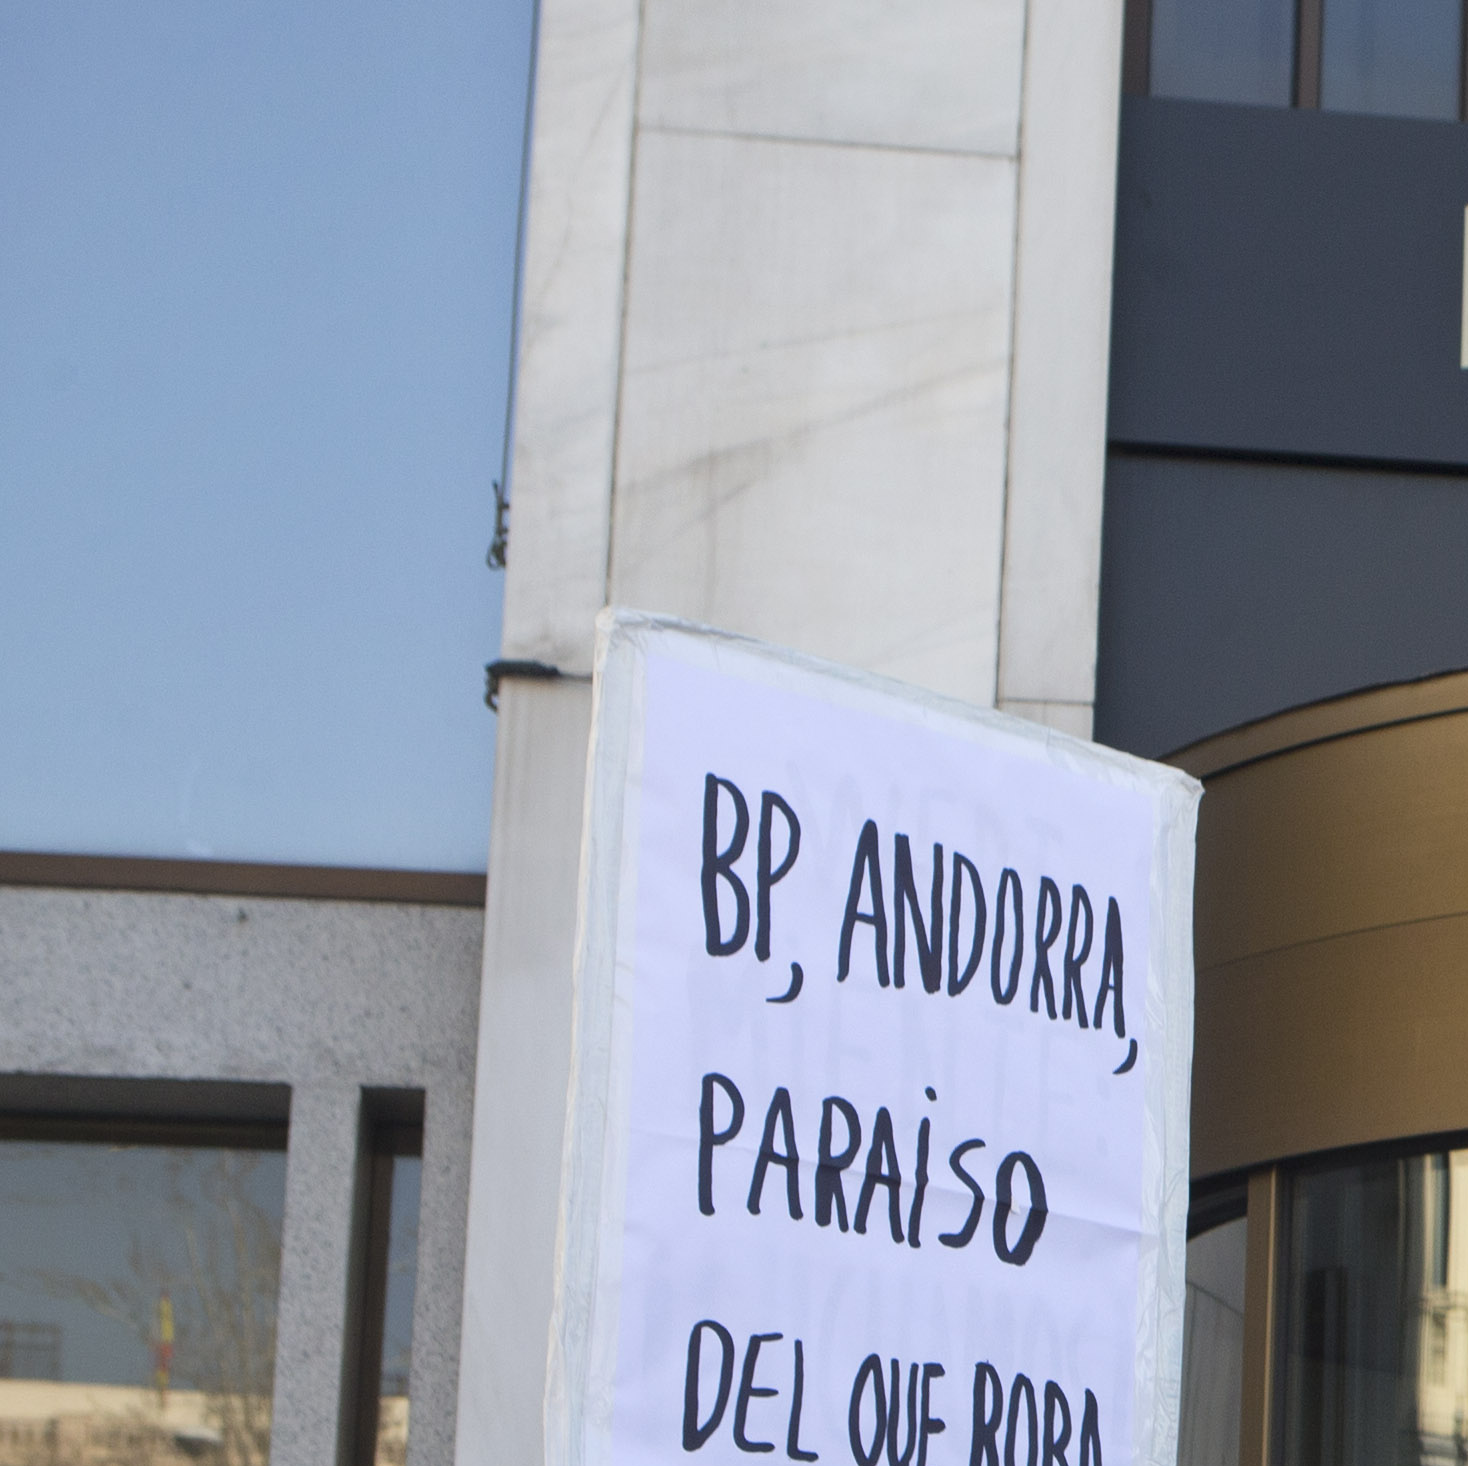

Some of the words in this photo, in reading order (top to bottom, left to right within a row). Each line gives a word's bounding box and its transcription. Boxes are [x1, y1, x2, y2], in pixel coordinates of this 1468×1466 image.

[700, 772, 803, 1003] BP,
[836, 818, 1139, 1075] ANDORRA,
[682, 1318, 819, 1462] DEL
